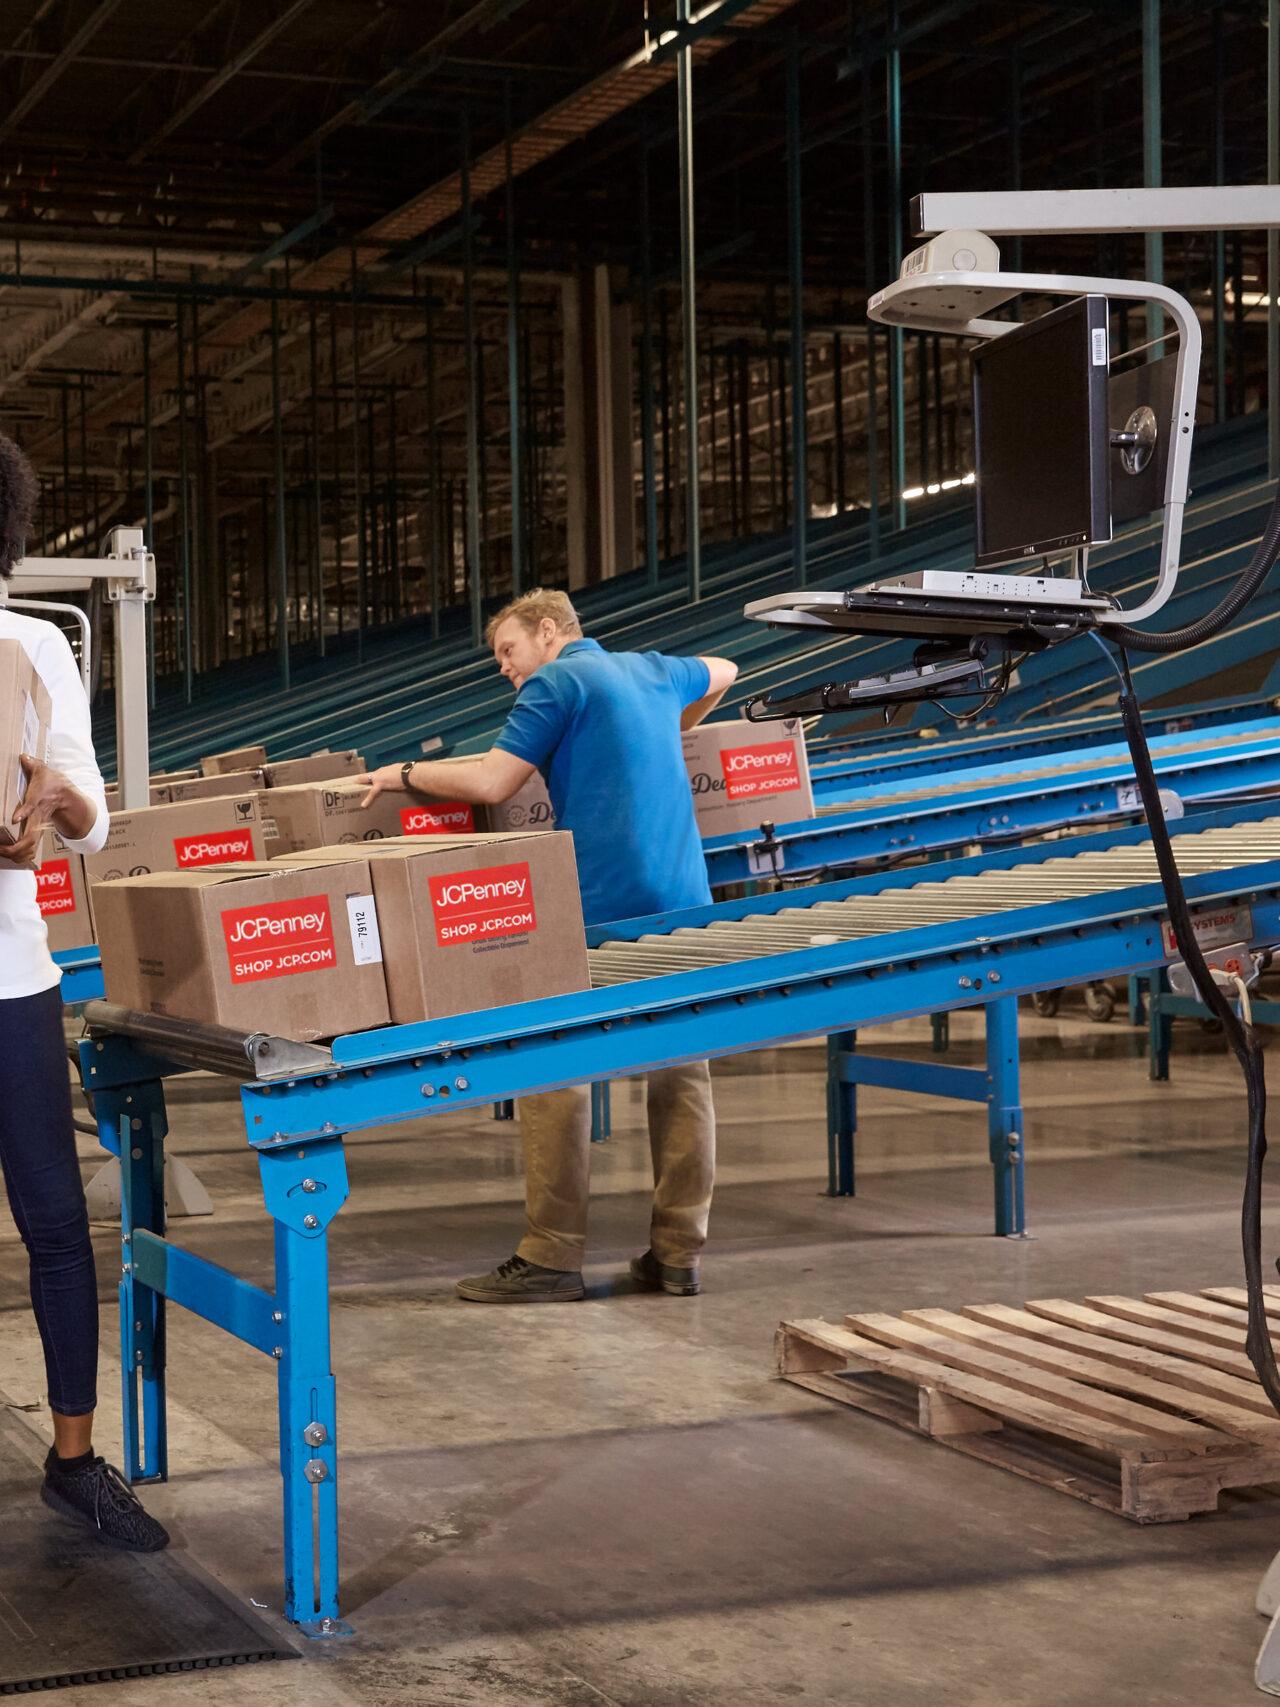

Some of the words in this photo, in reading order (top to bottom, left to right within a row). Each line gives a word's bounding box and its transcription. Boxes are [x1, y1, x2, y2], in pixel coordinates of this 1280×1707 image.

[726, 751, 793, 772] JCPenney
[730, 782, 757, 795] SHOP
[758, 776, 799, 791] JCP.COM
[325, 792, 341, 807] DF
[406, 811, 469, 830] JCPenney
[179, 839, 250, 862] JCPenney
[436, 878, 527, 908] JCPenney
[230, 911, 326, 944] JCPenney
[356, 911, 368, 938] 79112
[440, 922, 478, 940] SHOP
[480, 913, 532, 932] JCP.COM
[234, 957, 274, 977] SHOP
[276, 948, 332, 969] JCP.COM
